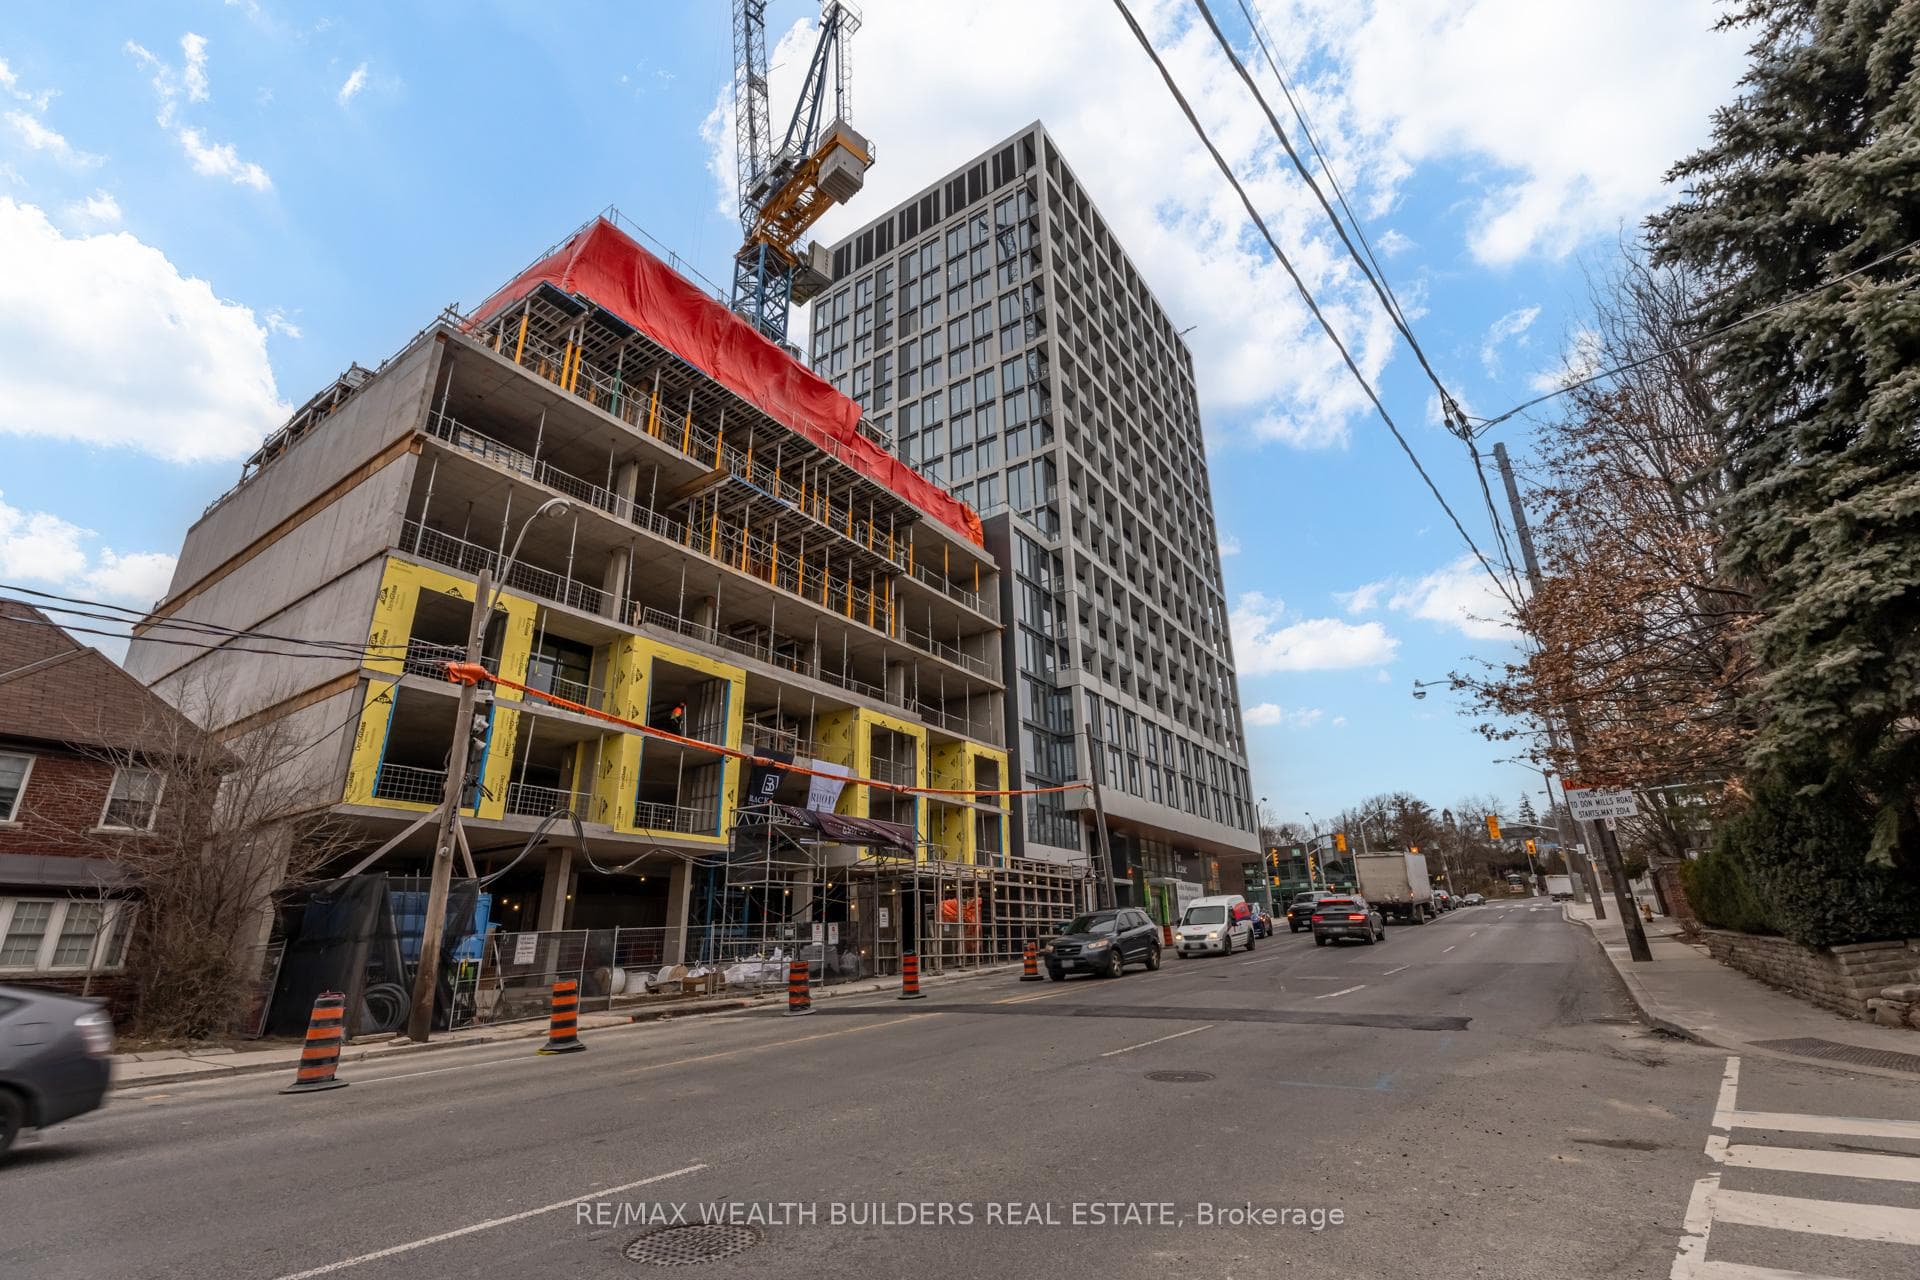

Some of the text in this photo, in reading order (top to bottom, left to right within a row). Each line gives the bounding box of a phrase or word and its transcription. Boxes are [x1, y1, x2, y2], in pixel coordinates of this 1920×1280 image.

[1570, 796, 1633, 809] TO DON MILLS ROAD
[1600, 808, 1614, 816] MAY
